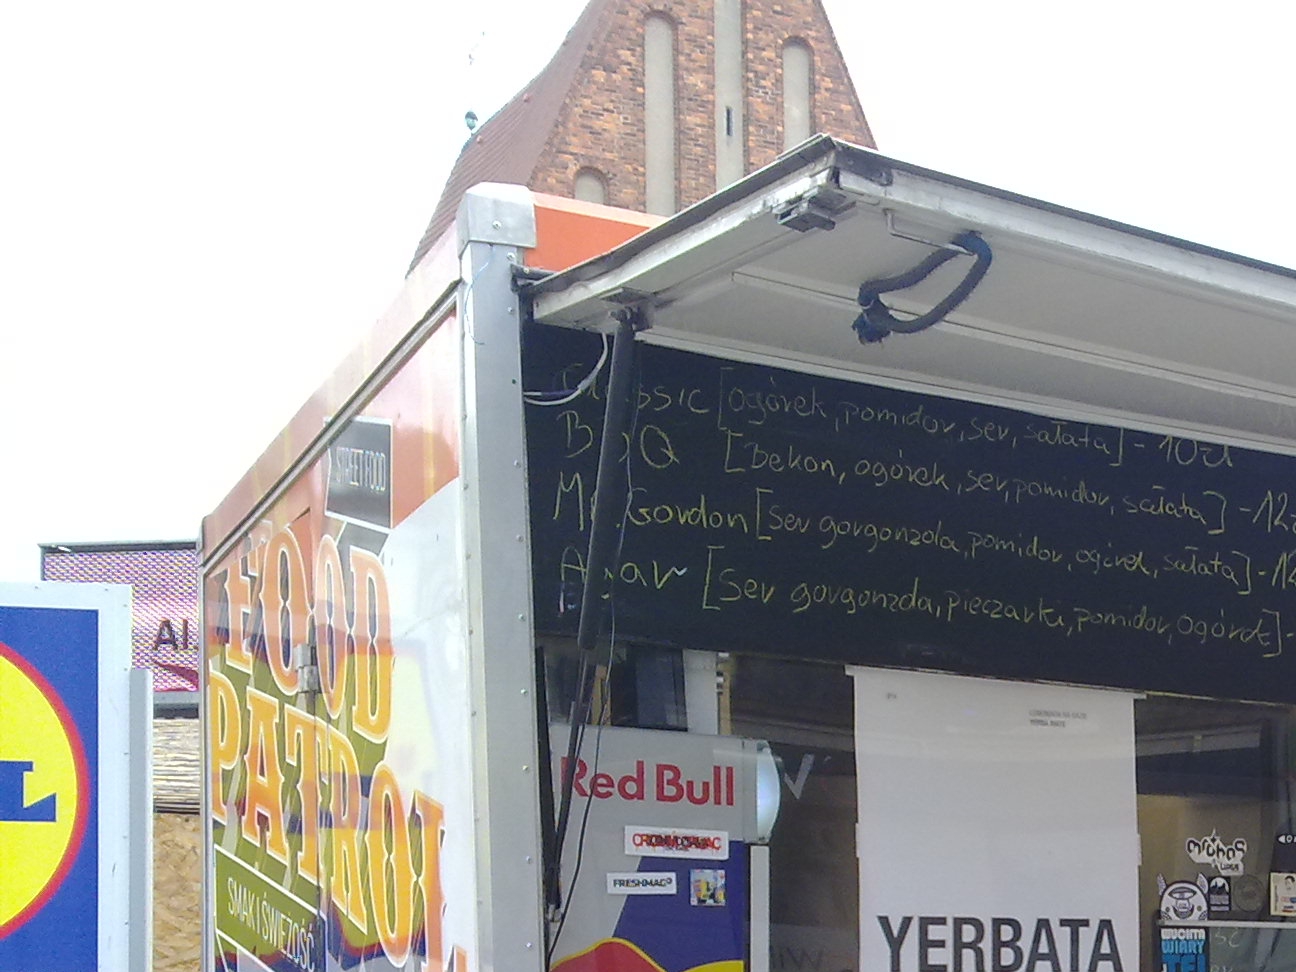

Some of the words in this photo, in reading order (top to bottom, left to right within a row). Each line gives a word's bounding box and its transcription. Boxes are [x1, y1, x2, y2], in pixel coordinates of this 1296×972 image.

[224, 518, 394, 744] FOOD
[561, 756, 645, 801] Red
[656, 763, 735, 807] Bull
[227, 876, 256, 931] SMAK
